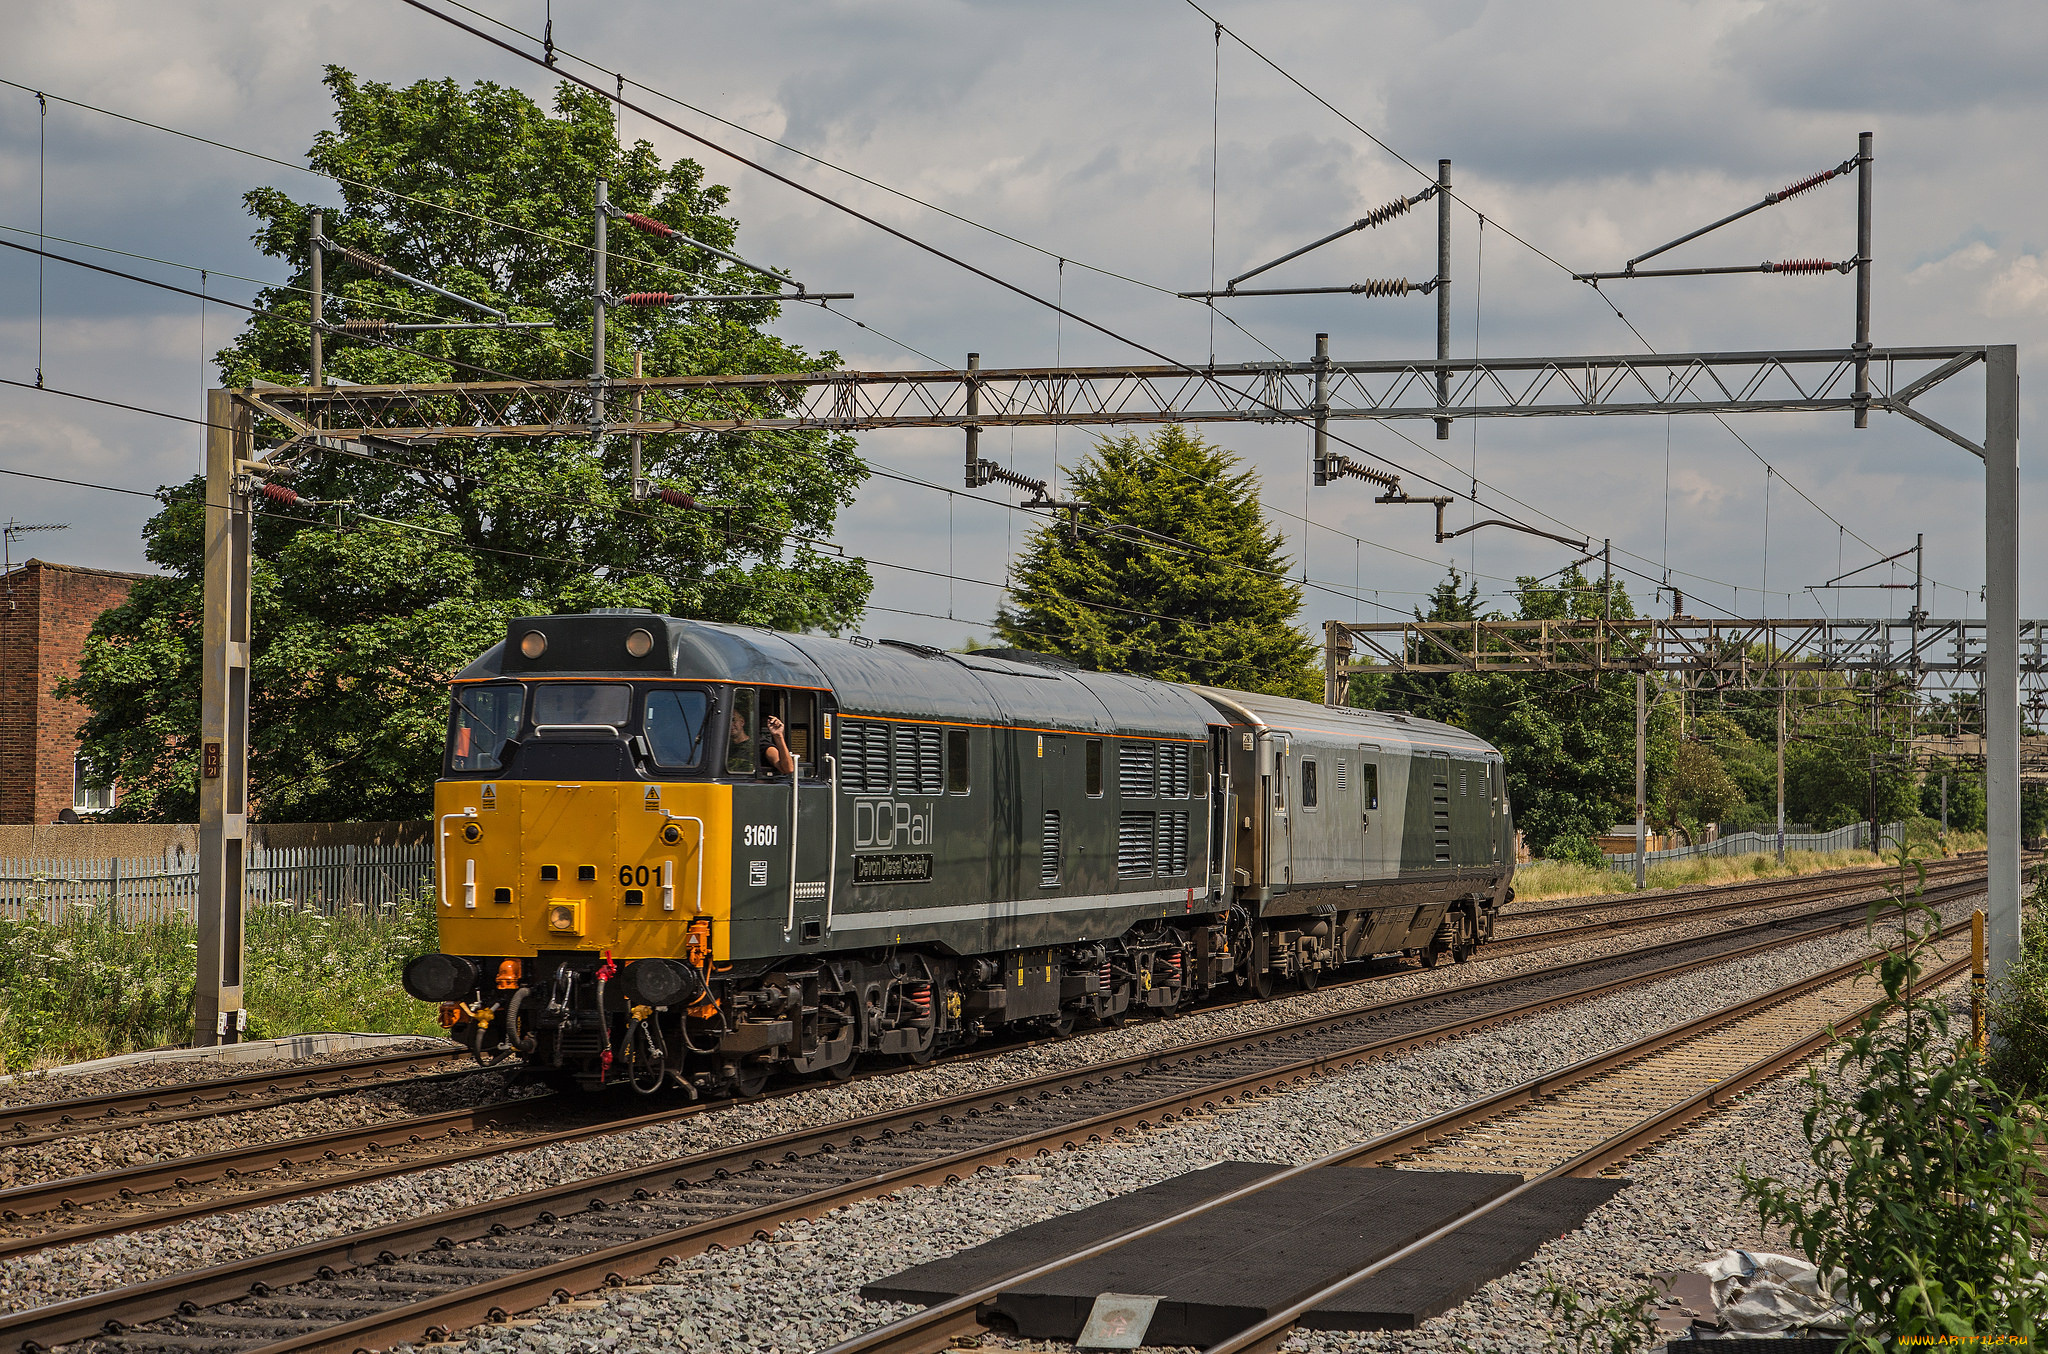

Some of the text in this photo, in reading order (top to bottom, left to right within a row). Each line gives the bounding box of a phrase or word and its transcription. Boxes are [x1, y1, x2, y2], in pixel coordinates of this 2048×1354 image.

[208, 744, 216, 753] G
[208, 755, 217, 765] 12
[207, 766, 217, 776] 21
[743, 824, 778, 846] 31601
[858, 856, 929, 877] Devon Diesel Society
[619, 865, 662, 887] 601
